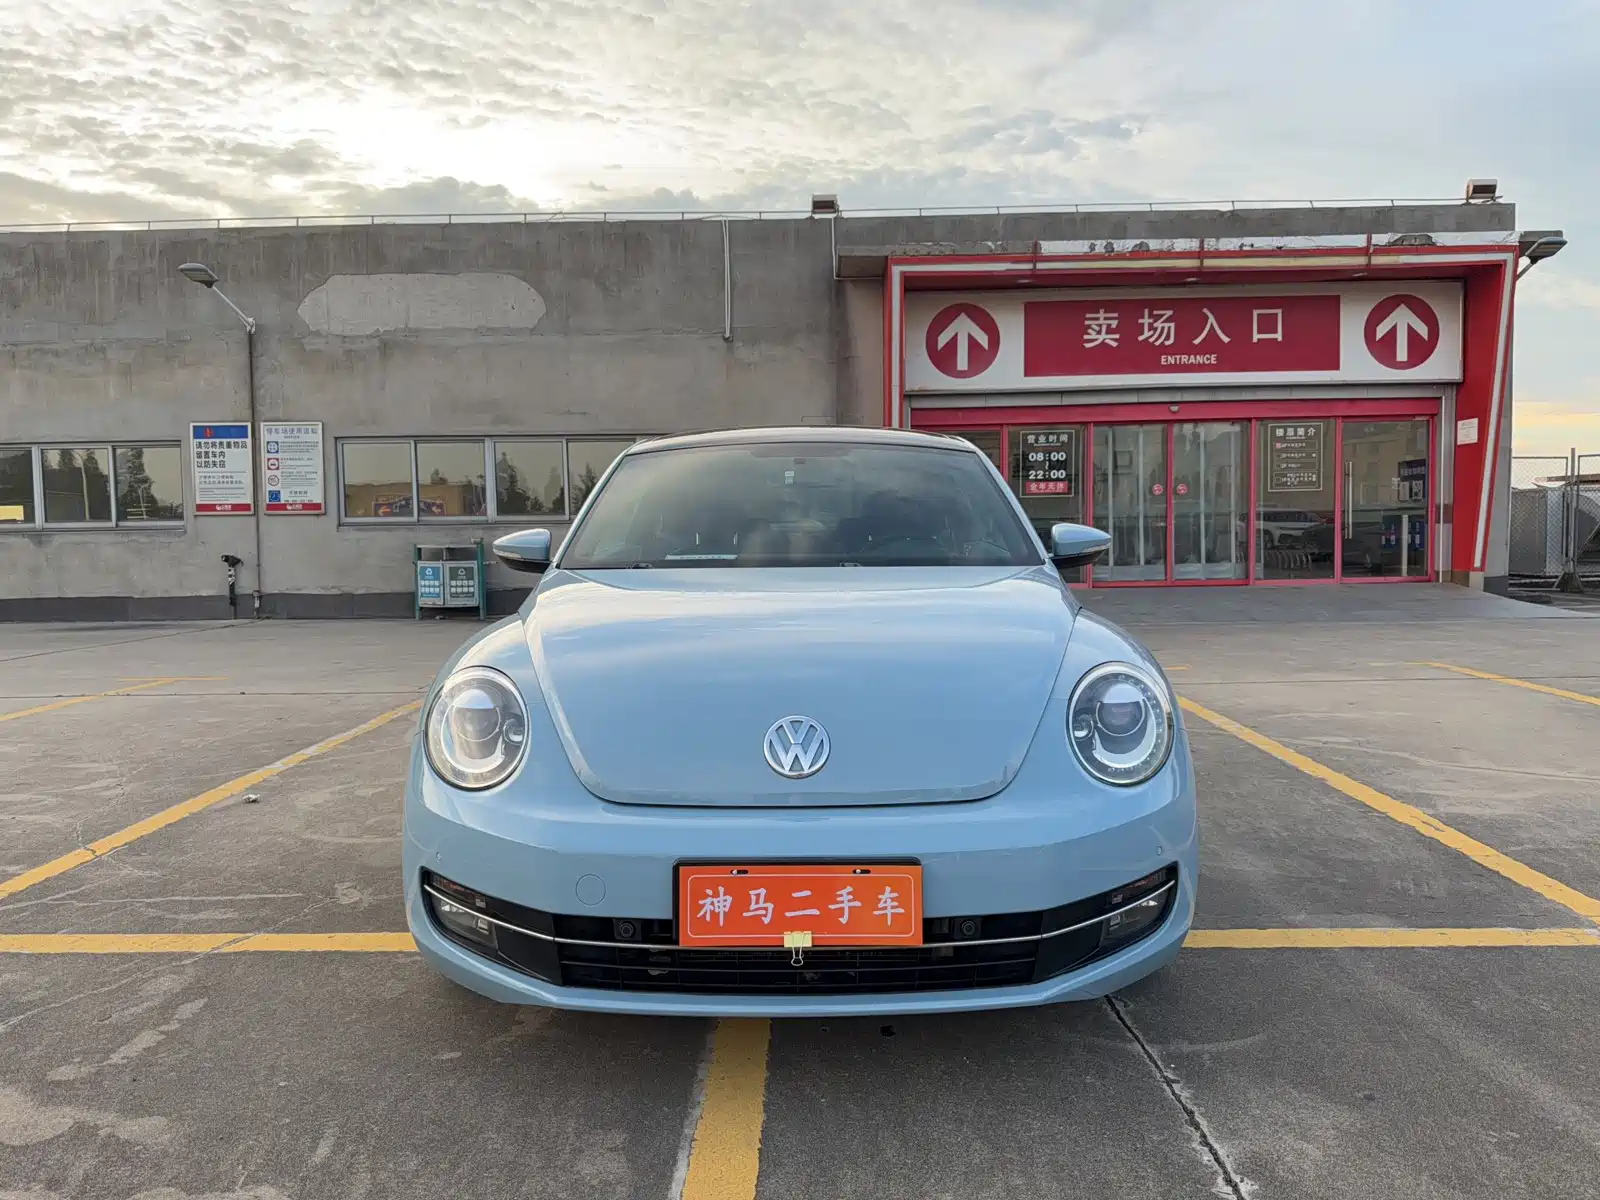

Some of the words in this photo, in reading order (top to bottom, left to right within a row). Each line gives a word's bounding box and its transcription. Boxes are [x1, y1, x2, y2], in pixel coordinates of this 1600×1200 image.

[1082, 308, 1285, 348] 卖场入口
[1160, 353, 1218, 366] ENTRANCE
[1027, 434, 1068, 443] 营业时间
[195, 441, 248, 450] 请勿将贵重物品
[196, 450, 227, 459] 留置车内
[1028, 452, 1066, 461] 08:00
[196, 460, 227, 469] 以防失窃
[1028, 469, 1066, 479] 22:00
[1029, 482, 1065, 491] 全年无休
[766, 717, 828, 777] VW
[696, 885, 905, 927] 神马二手车
